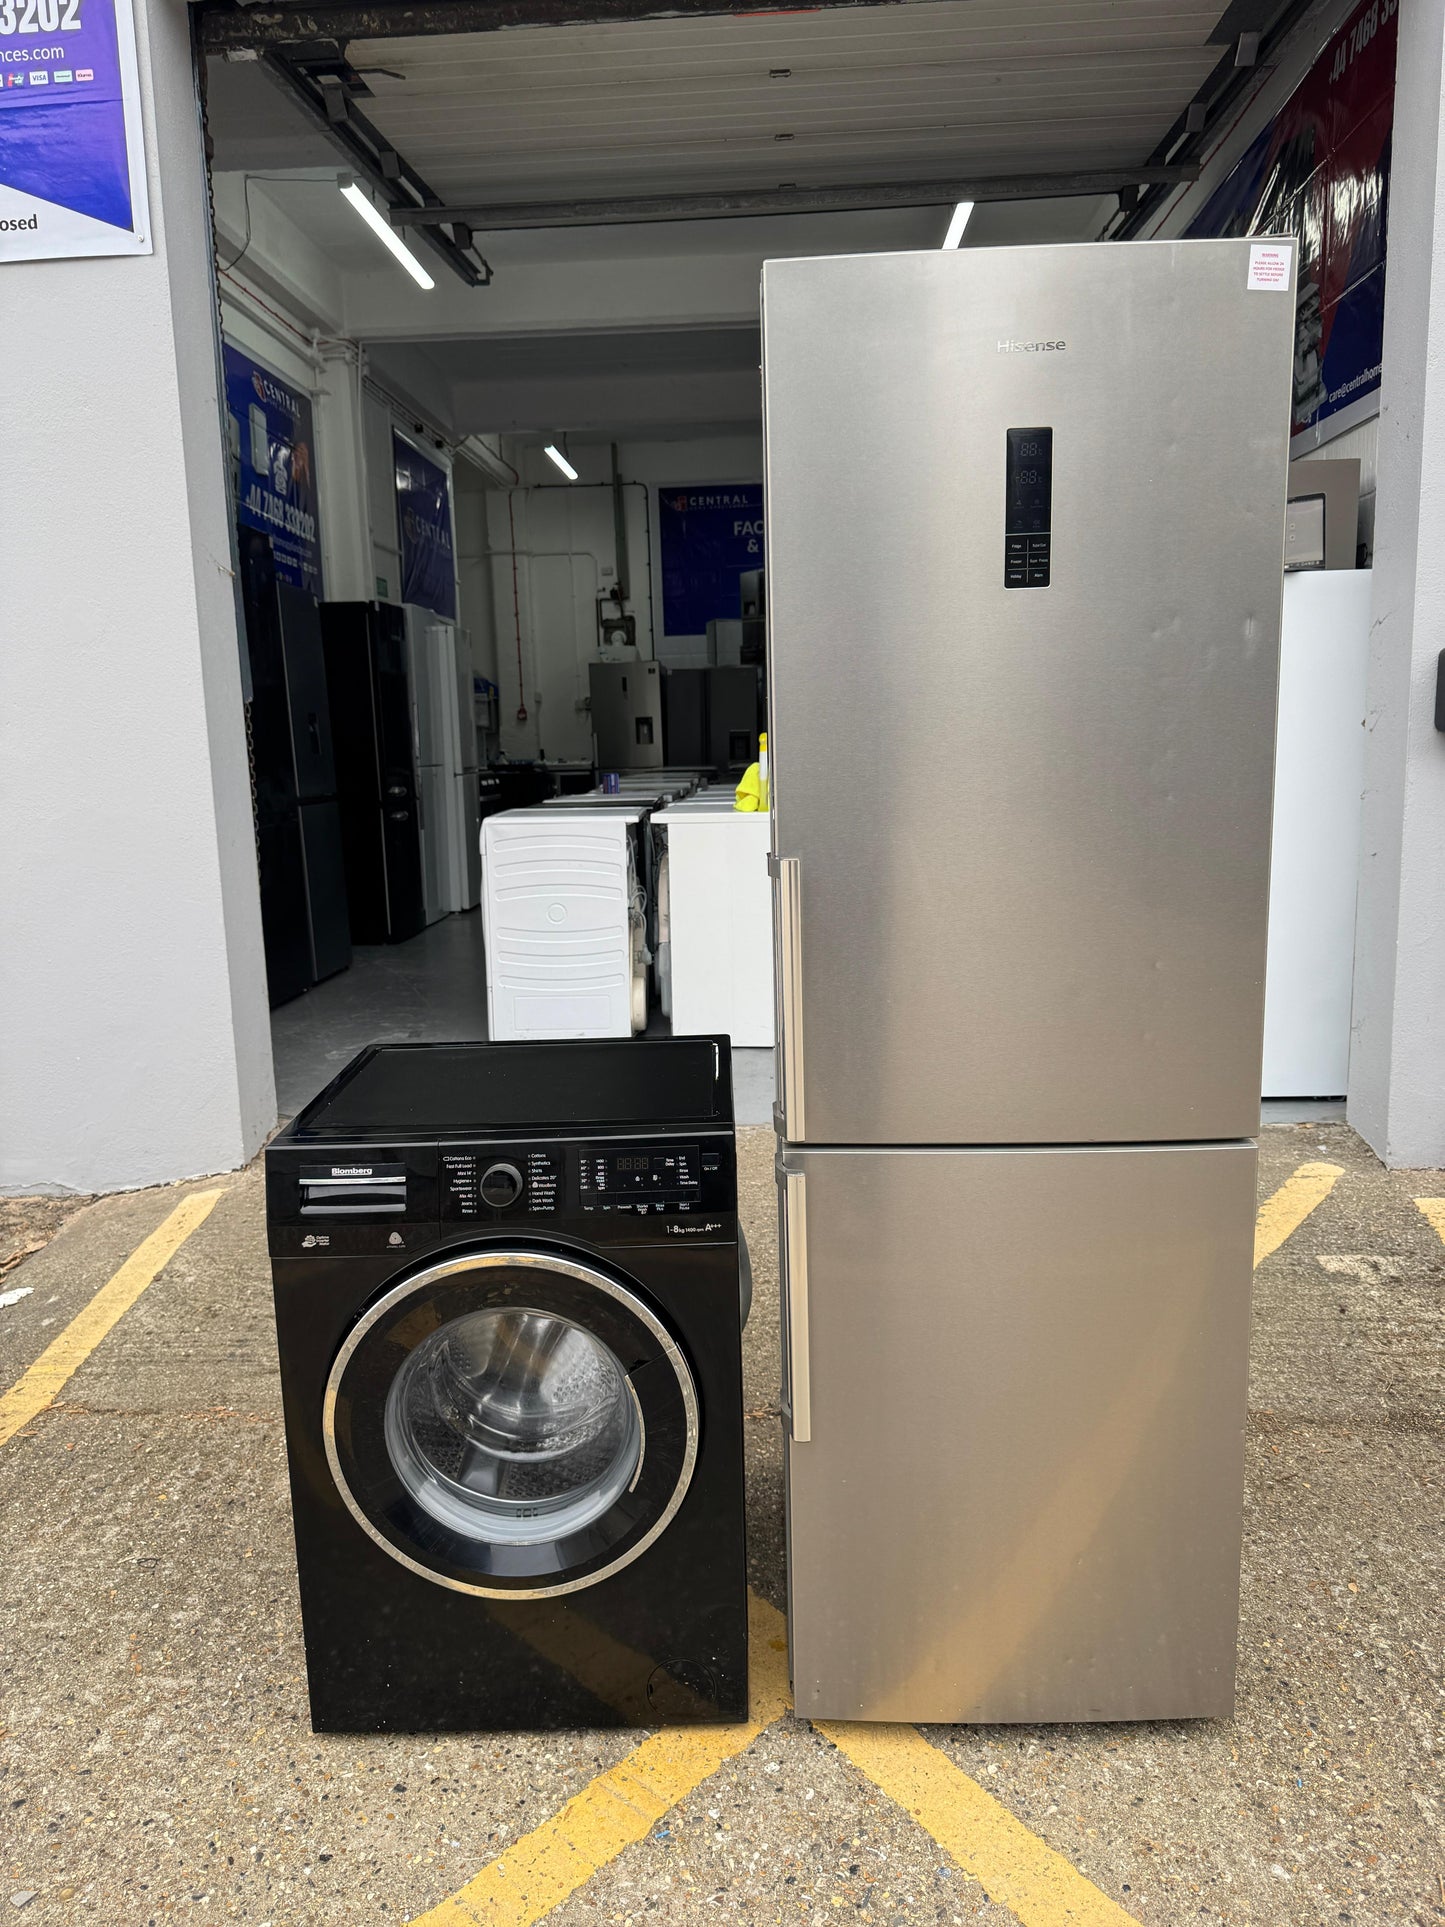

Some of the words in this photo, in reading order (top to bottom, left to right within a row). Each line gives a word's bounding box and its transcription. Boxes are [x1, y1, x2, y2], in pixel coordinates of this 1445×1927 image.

[1349, 0, 1379, 65] 7468
[0, 213, 38, 231] osed
[997, 340, 1066, 353] Hisense
[264, 379, 301, 419] CENTRAL
[690, 494, 748, 506] CENTRAL
[416, 515, 451, 550] CENTRAL
[747, 539, 759, 553] &
[331, 1167, 373, 1176] Blomberg
[705, 1223, 722, 1232] A+++
